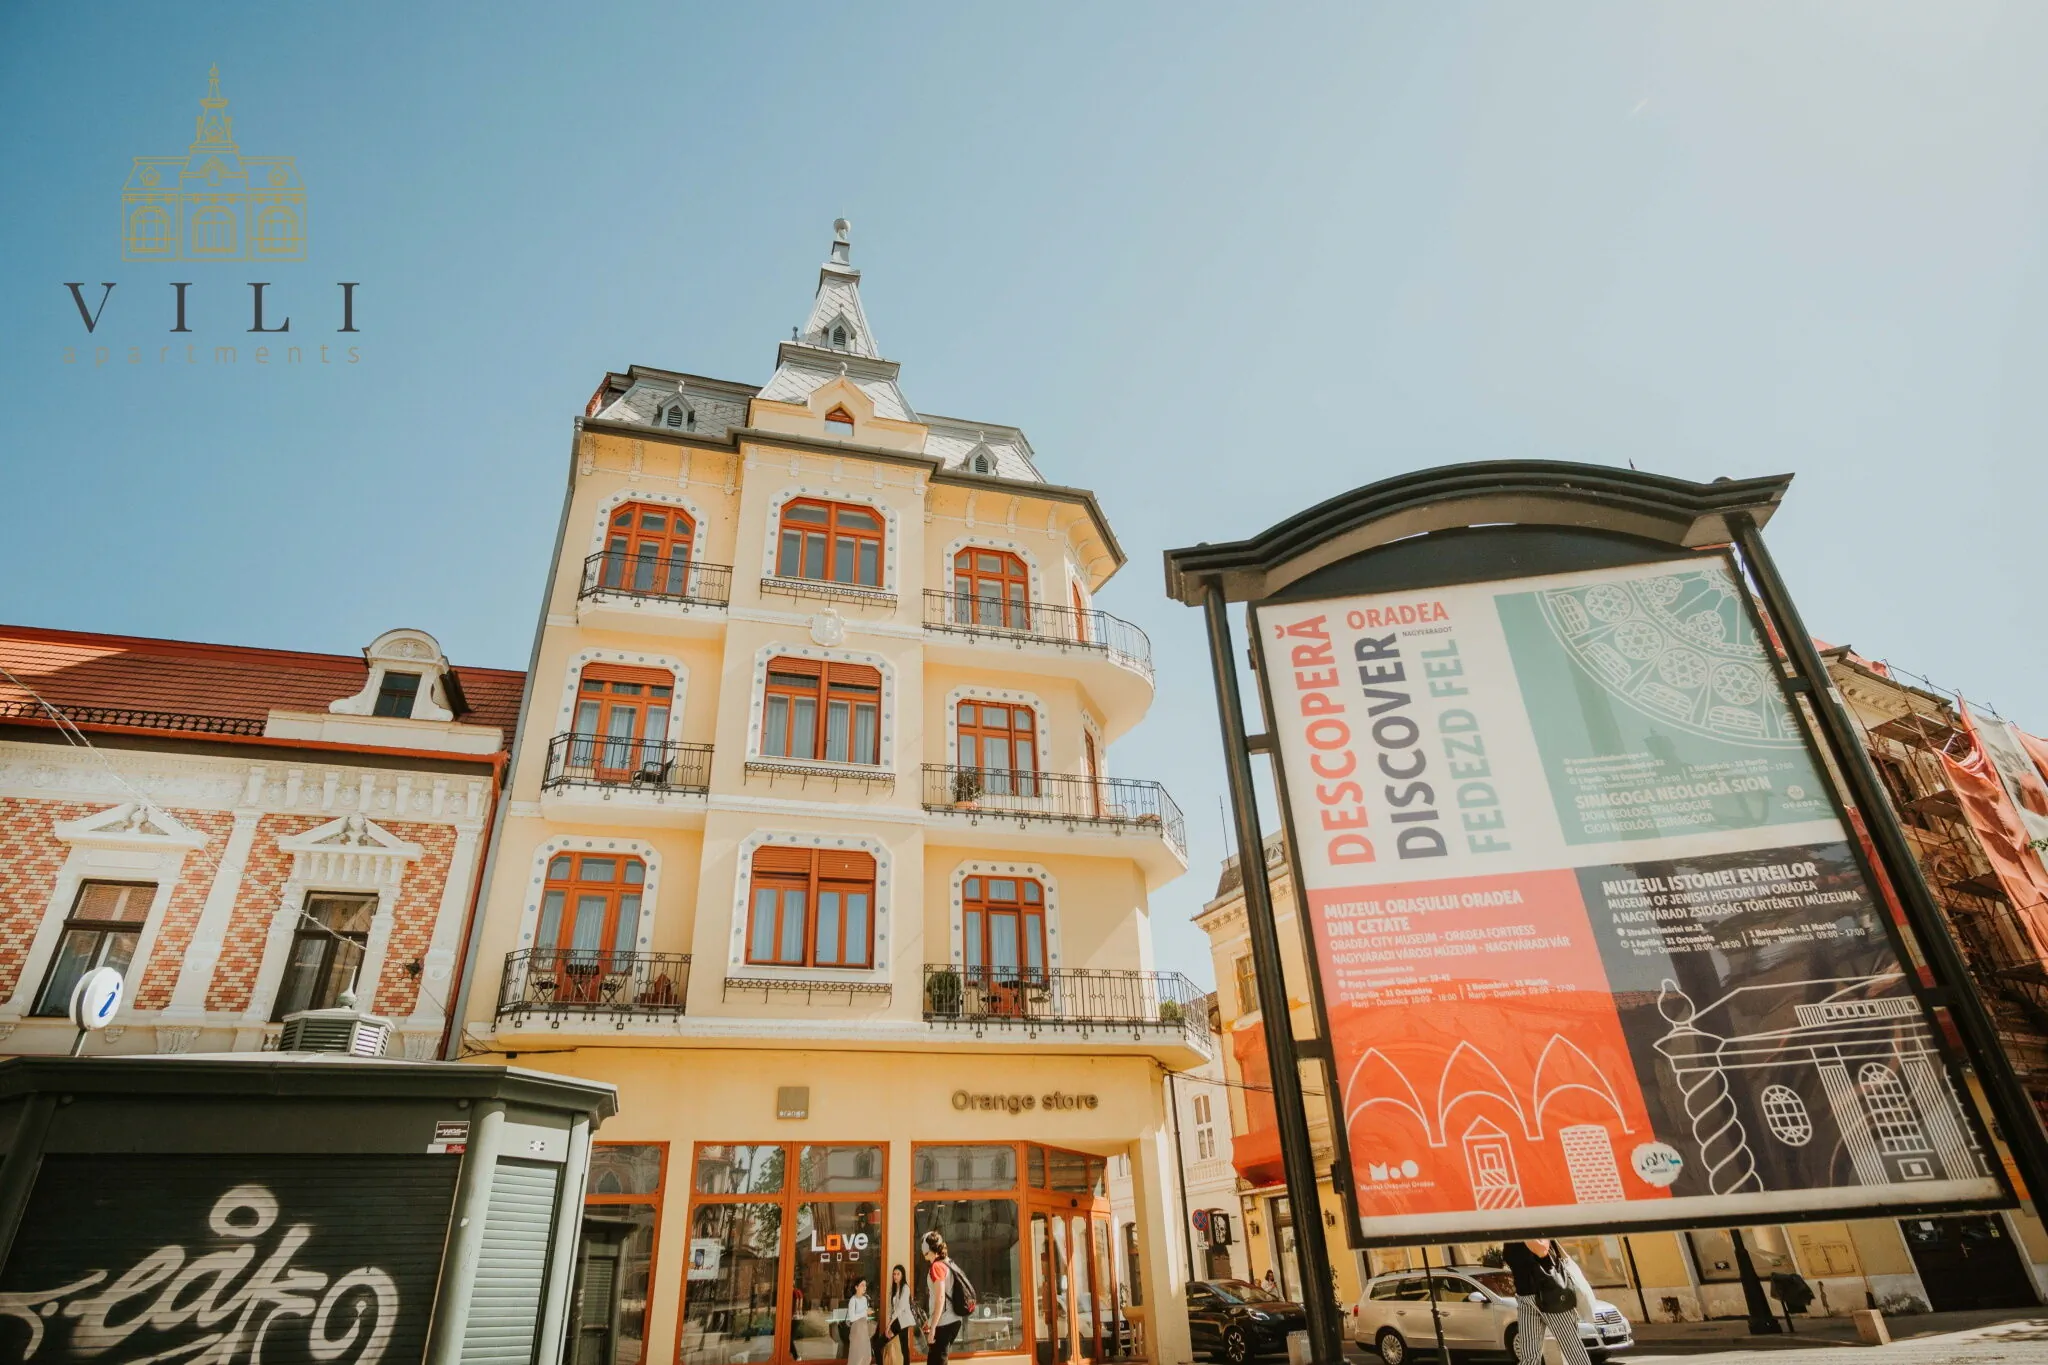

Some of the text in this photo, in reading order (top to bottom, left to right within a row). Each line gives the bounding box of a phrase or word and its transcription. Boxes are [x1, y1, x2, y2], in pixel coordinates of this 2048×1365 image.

[1346, 601, 1449, 631] ORADEA
[1274, 614, 1377, 865] DESCOPERĂ
[1354, 633, 1448, 860] DISCOVER
[1421, 639, 1512, 854] FEDEZD FEL
[1575, 776, 1772, 809] SINAGOGA NEOLOGĂ SION
[1607, 806, 1649, 819] NEOLOG
[1602, 861, 1819, 896] MUZEUL ISTORIEI EVREILOR
[1324, 889, 1524, 919] MUZEUL ORAȘULUI ORADEA
[1608, 880, 1818, 910] MUSEUM OF JEWISH HISTORY IN ORADEA
[1612, 890, 1861, 924] A NAGYVÁRADI ZSIDÓSÁG TÖRTÉNETI MÚZEUMA
[1327, 917, 1411, 937] DIN CETATE
[1330, 937, 1370, 951] ORADEA
[1371, 936, 1393, 947] CITY
[1395, 932, 1437, 945] MUSEUM
[1445, 929, 1486, 941] ORADEA
[1486, 924, 1536, 937] FORTRESS
[1332, 949, 1395, 964] NAGYVÁRADI
[1396, 946, 1432, 961] VÁROSI
[1434, 943, 1478, 957] MÚZEUM
[1485, 938, 1549, 953] NAGYVÁRADI
[1550, 934, 1571, 947] VÁR
[952, 1089, 1099, 1115] Orange store
